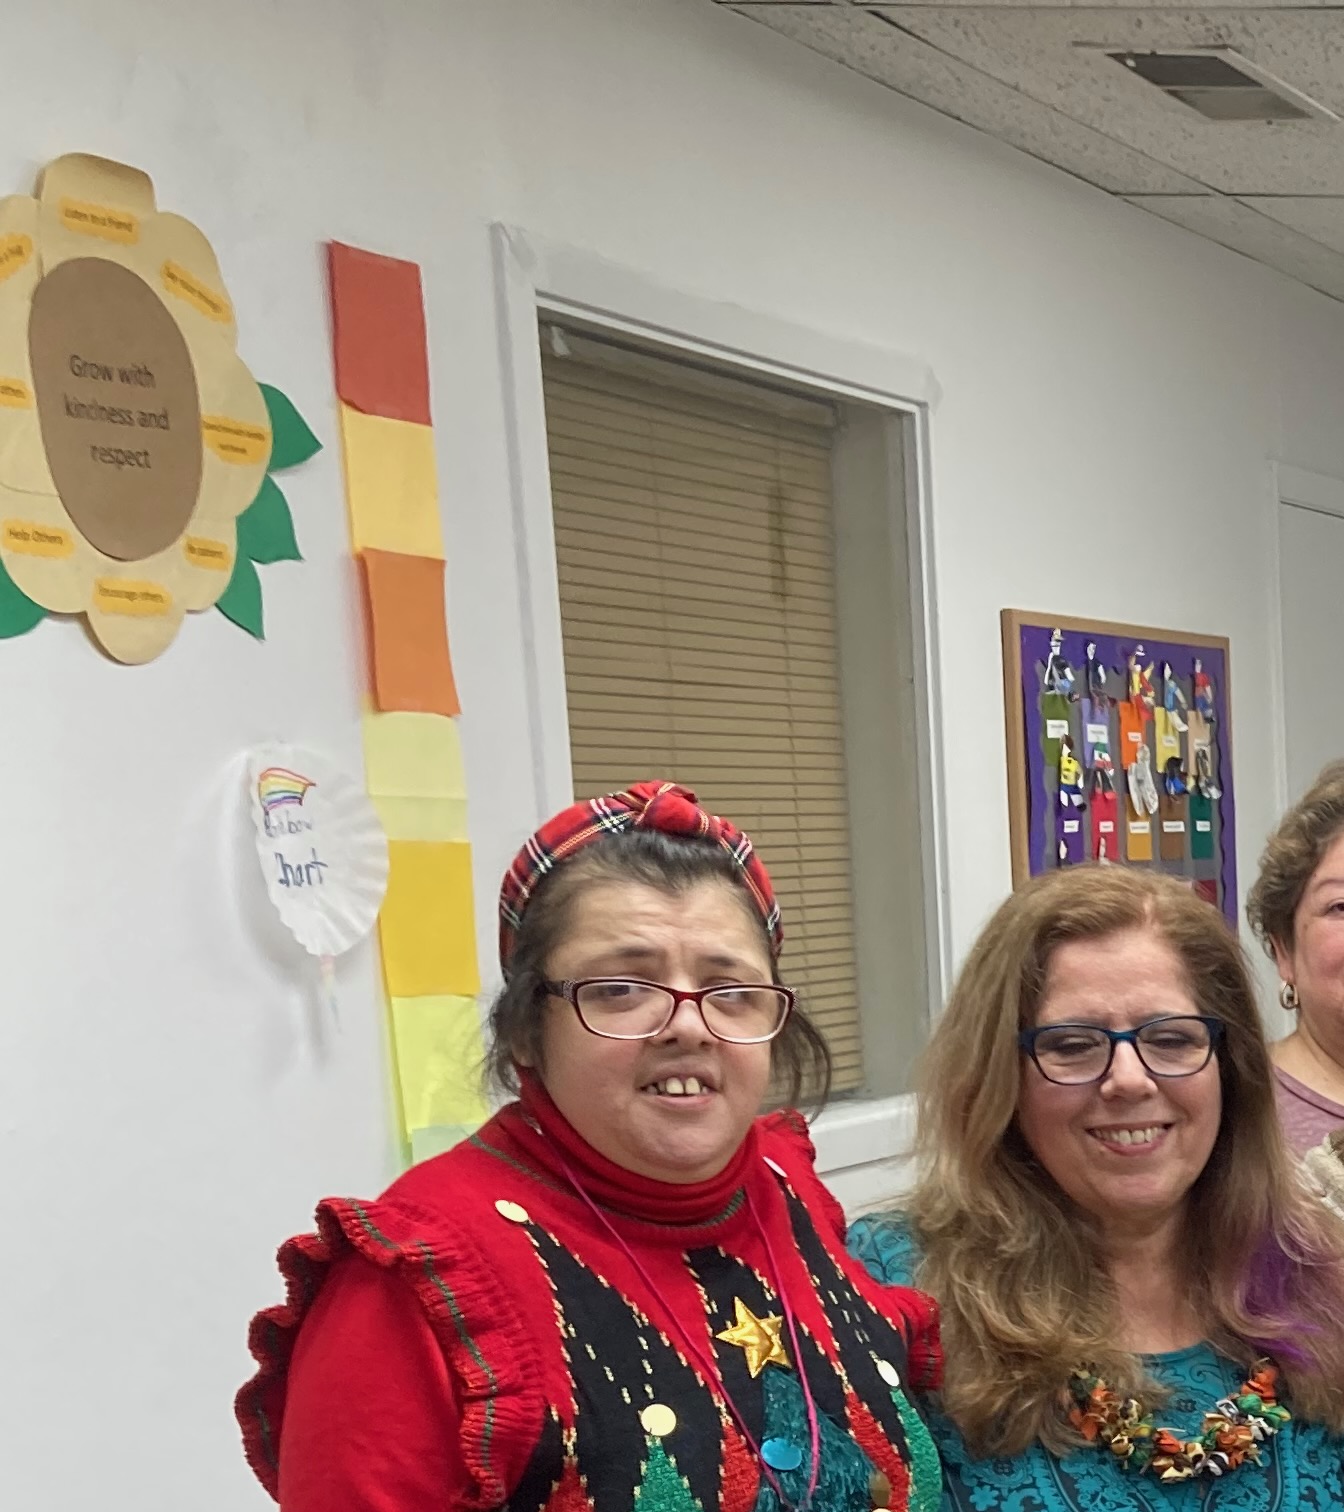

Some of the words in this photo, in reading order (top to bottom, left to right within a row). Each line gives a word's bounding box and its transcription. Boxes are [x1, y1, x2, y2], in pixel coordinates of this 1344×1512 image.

[118, 362, 156, 390] with
[65, 394, 135, 427] kindness
[137, 406, 170, 432] and
[90, 443, 152, 471] respect
